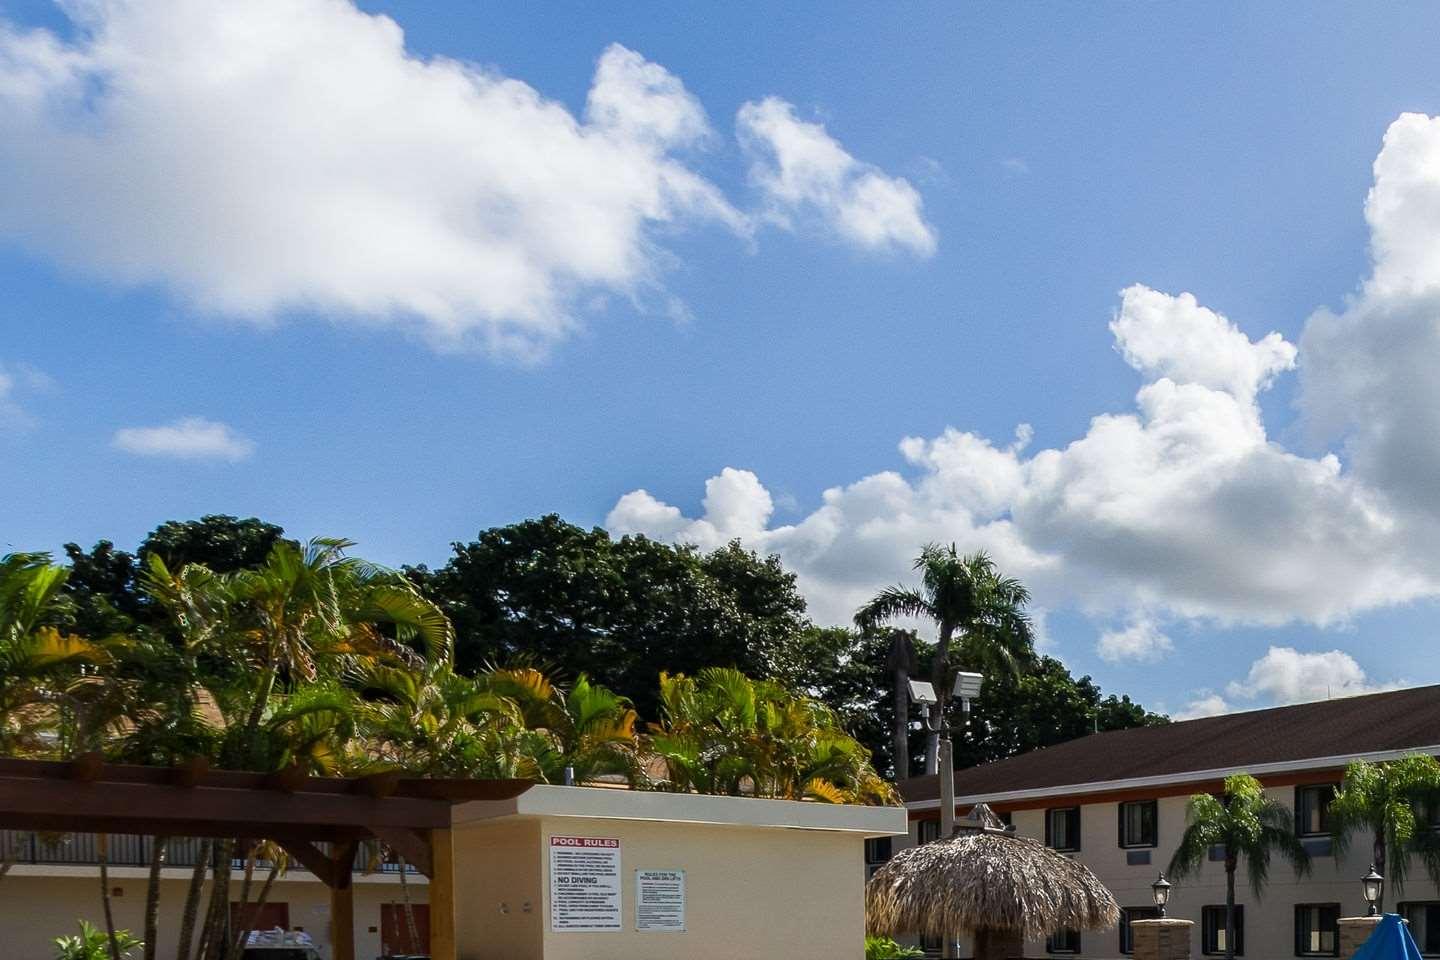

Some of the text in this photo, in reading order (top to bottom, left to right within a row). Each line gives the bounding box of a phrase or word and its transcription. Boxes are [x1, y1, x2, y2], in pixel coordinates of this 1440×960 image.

[552, 838, 617, 847] POOL RULES
[558, 876, 570, 884] NO
